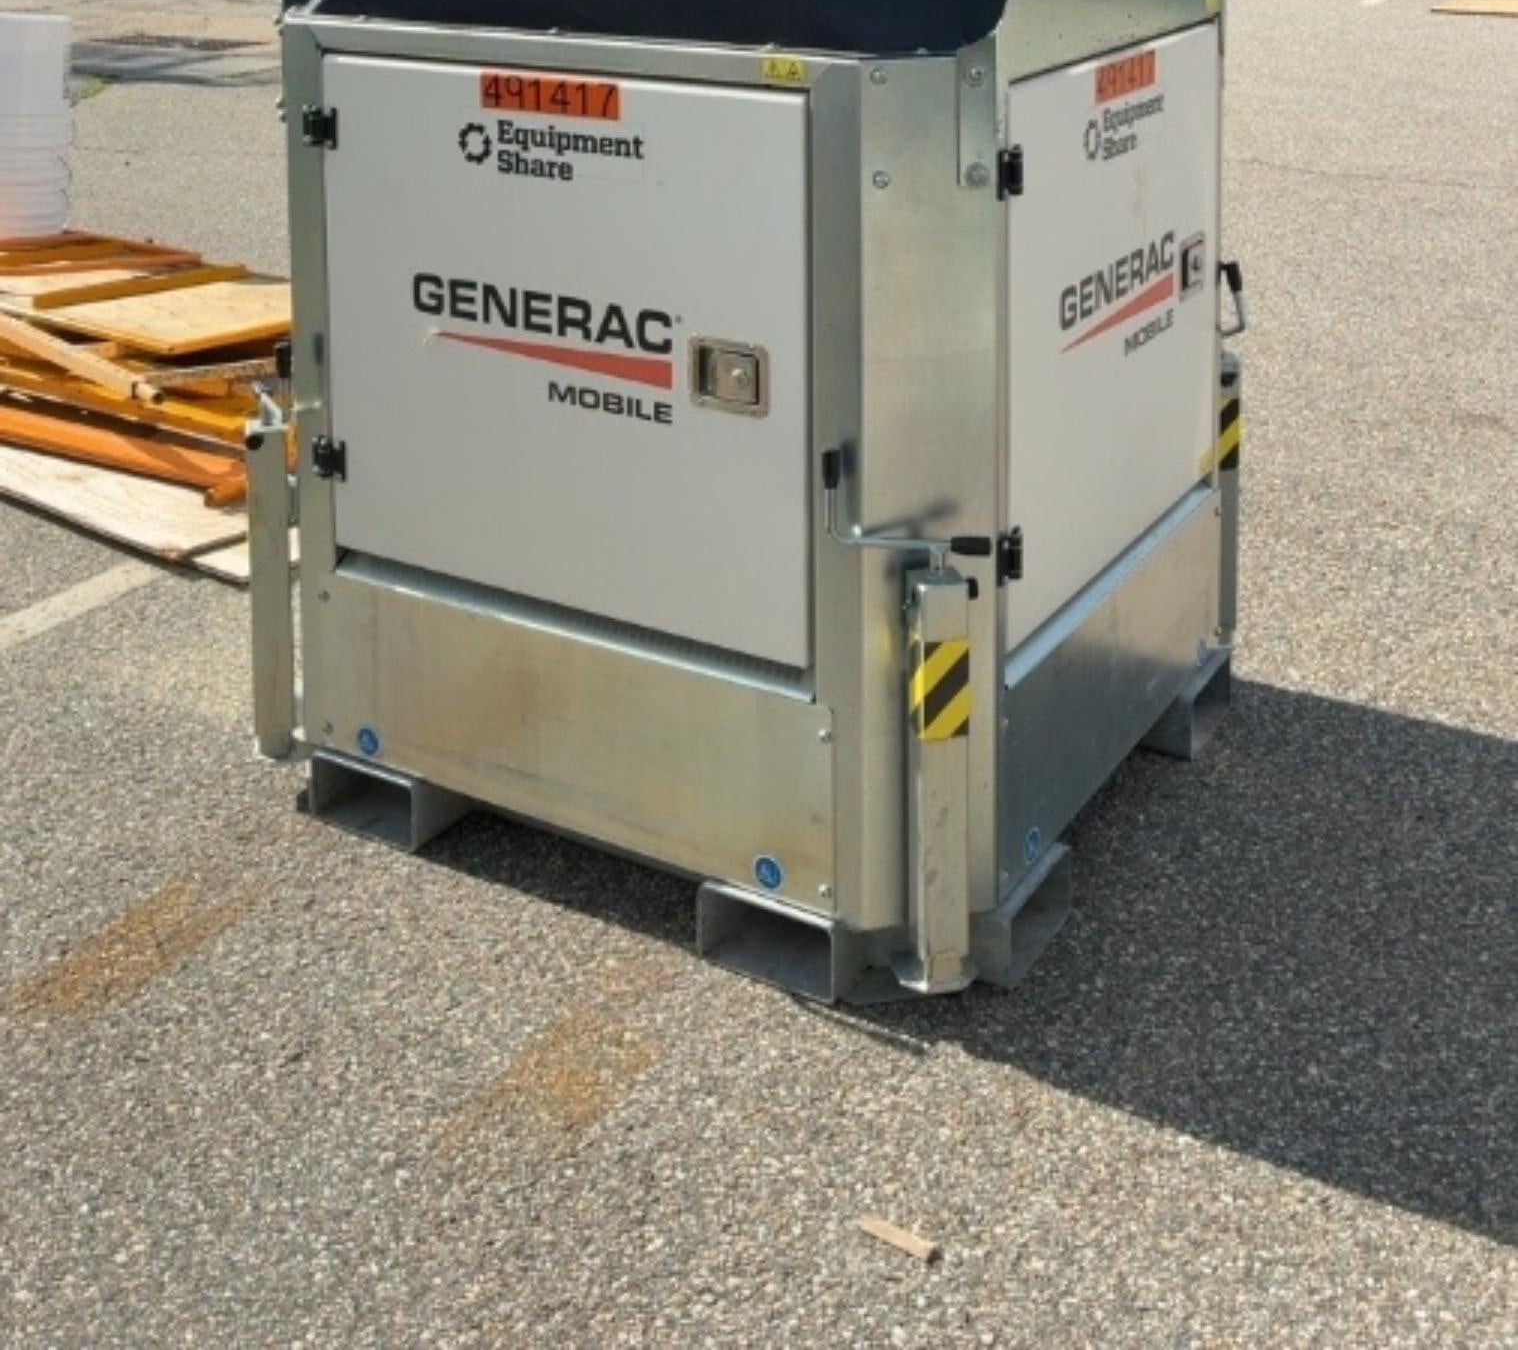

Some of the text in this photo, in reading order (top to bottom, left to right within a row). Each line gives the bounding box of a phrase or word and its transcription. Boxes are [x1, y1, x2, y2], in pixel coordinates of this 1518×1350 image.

[483, 74, 617, 117] 491417
[1103, 94, 1164, 136] Equipment
[497, 119, 645, 160] Equipment
[1102, 132, 1138, 162] Share
[497, 150, 573, 181] Share
[1059, 230, 1175, 331] GENERAC
[412, 272, 673, 354] GENERAC
[1123, 308, 1174, 358] MOBILE
[548, 380, 673, 426] MOBILE
